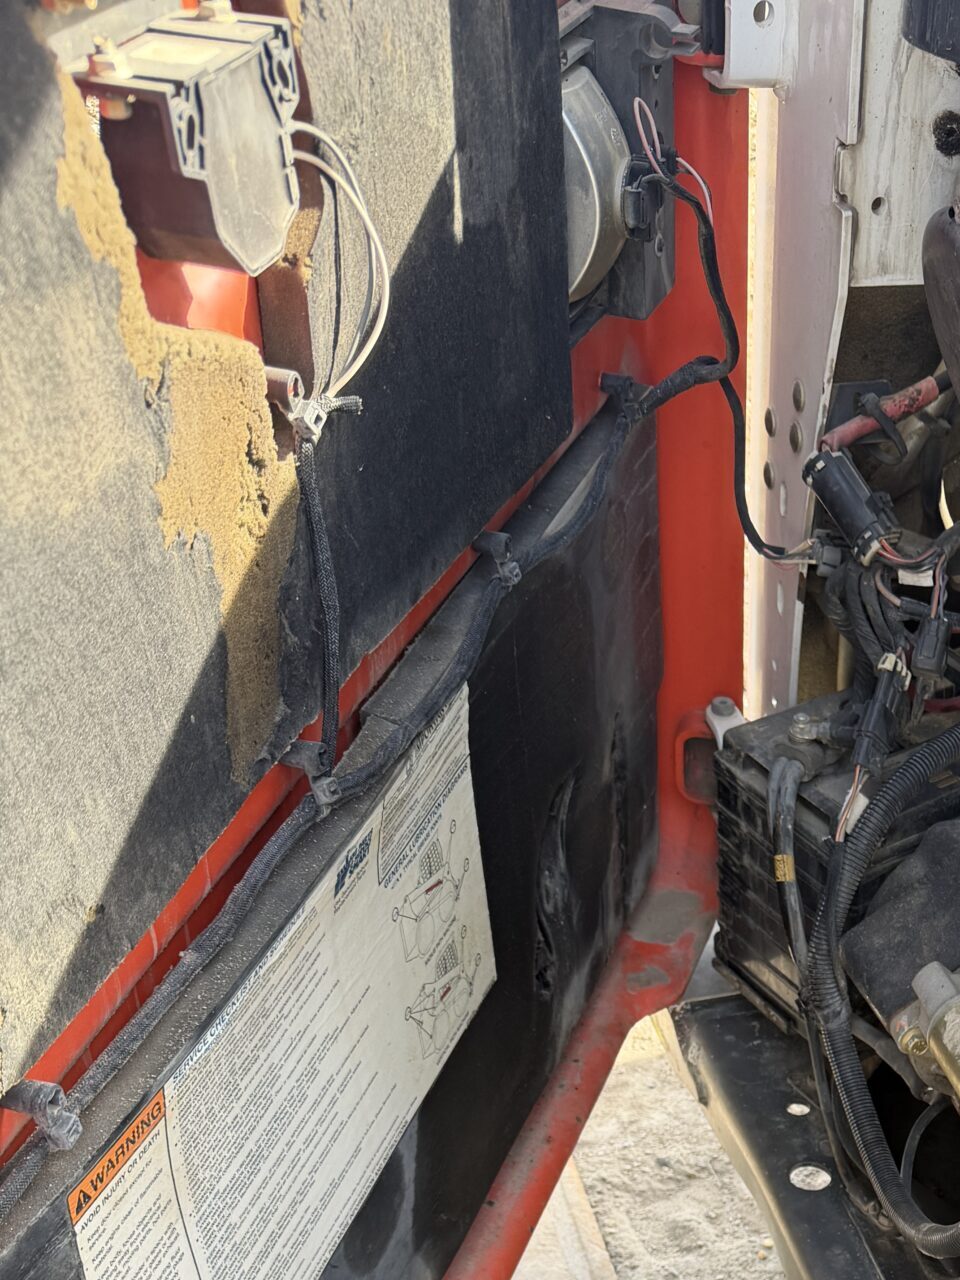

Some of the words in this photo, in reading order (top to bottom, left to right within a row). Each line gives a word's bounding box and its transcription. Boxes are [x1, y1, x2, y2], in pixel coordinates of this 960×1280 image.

[172, 1034, 211, 1083] SERVICE
[209, 982, 252, 1036] CHECKLIST
[80, 1206, 101, 1234] AVOID
[102, 1171, 126, 1208] INJURY
[138, 1129, 161, 1159] DEATH
[90, 1101, 162, 1192] WARNING
